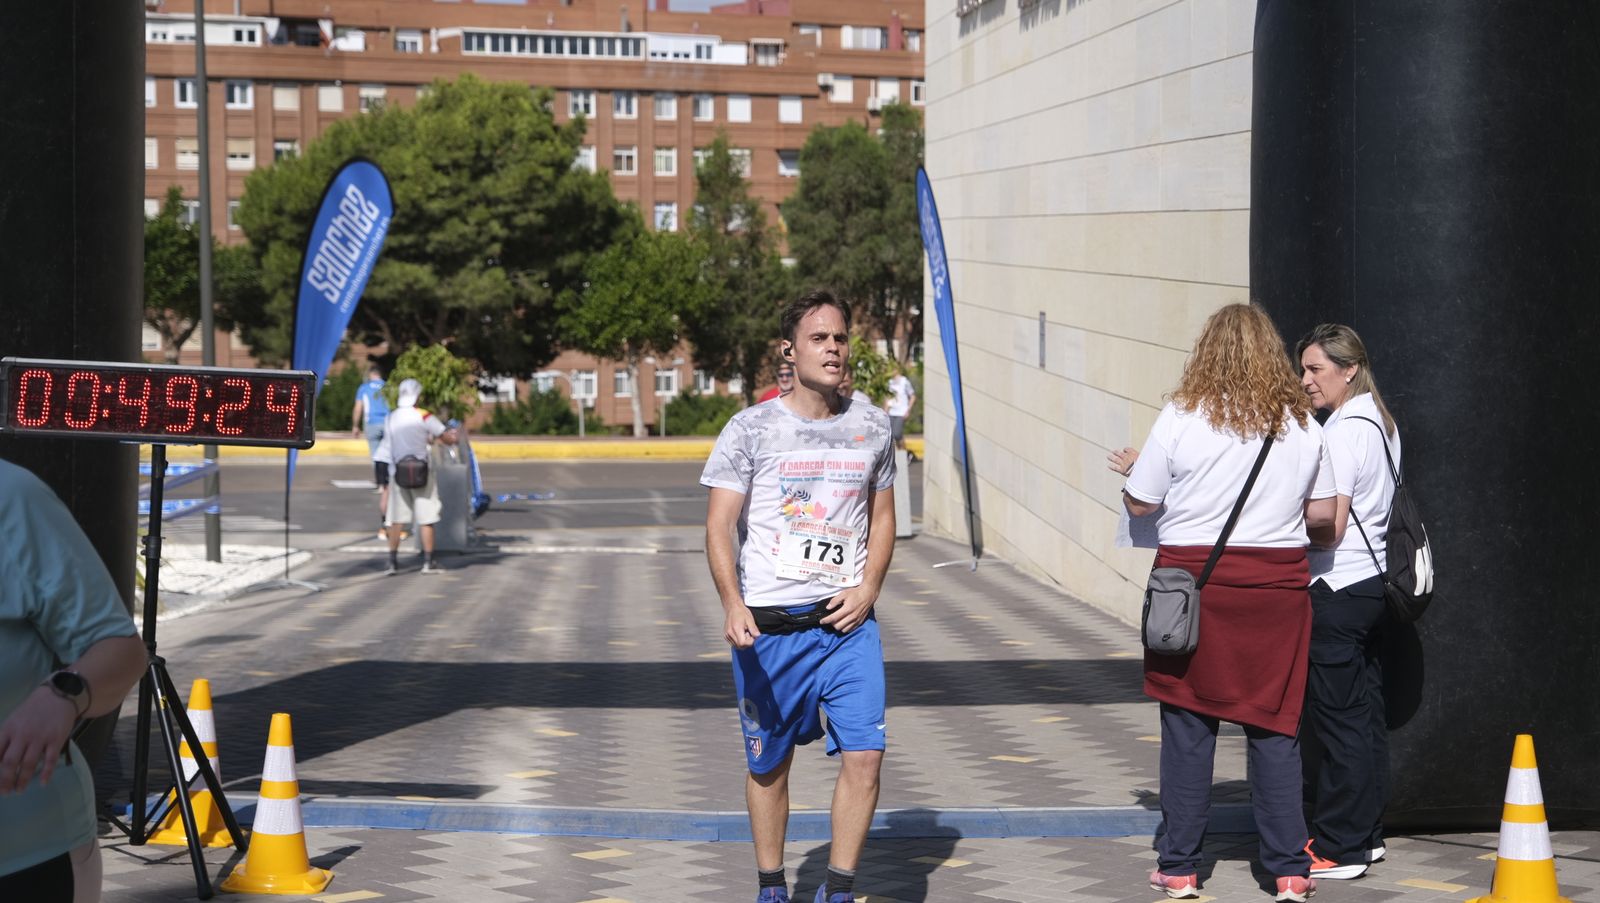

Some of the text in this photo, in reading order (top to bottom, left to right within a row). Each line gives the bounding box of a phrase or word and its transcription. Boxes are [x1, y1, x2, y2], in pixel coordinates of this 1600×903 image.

[17, 370, 299, 434] 00:49:24
[827, 461, 842, 470] SIN
[844, 461, 866, 471] HUMO
[800, 538, 844, 565] 173
